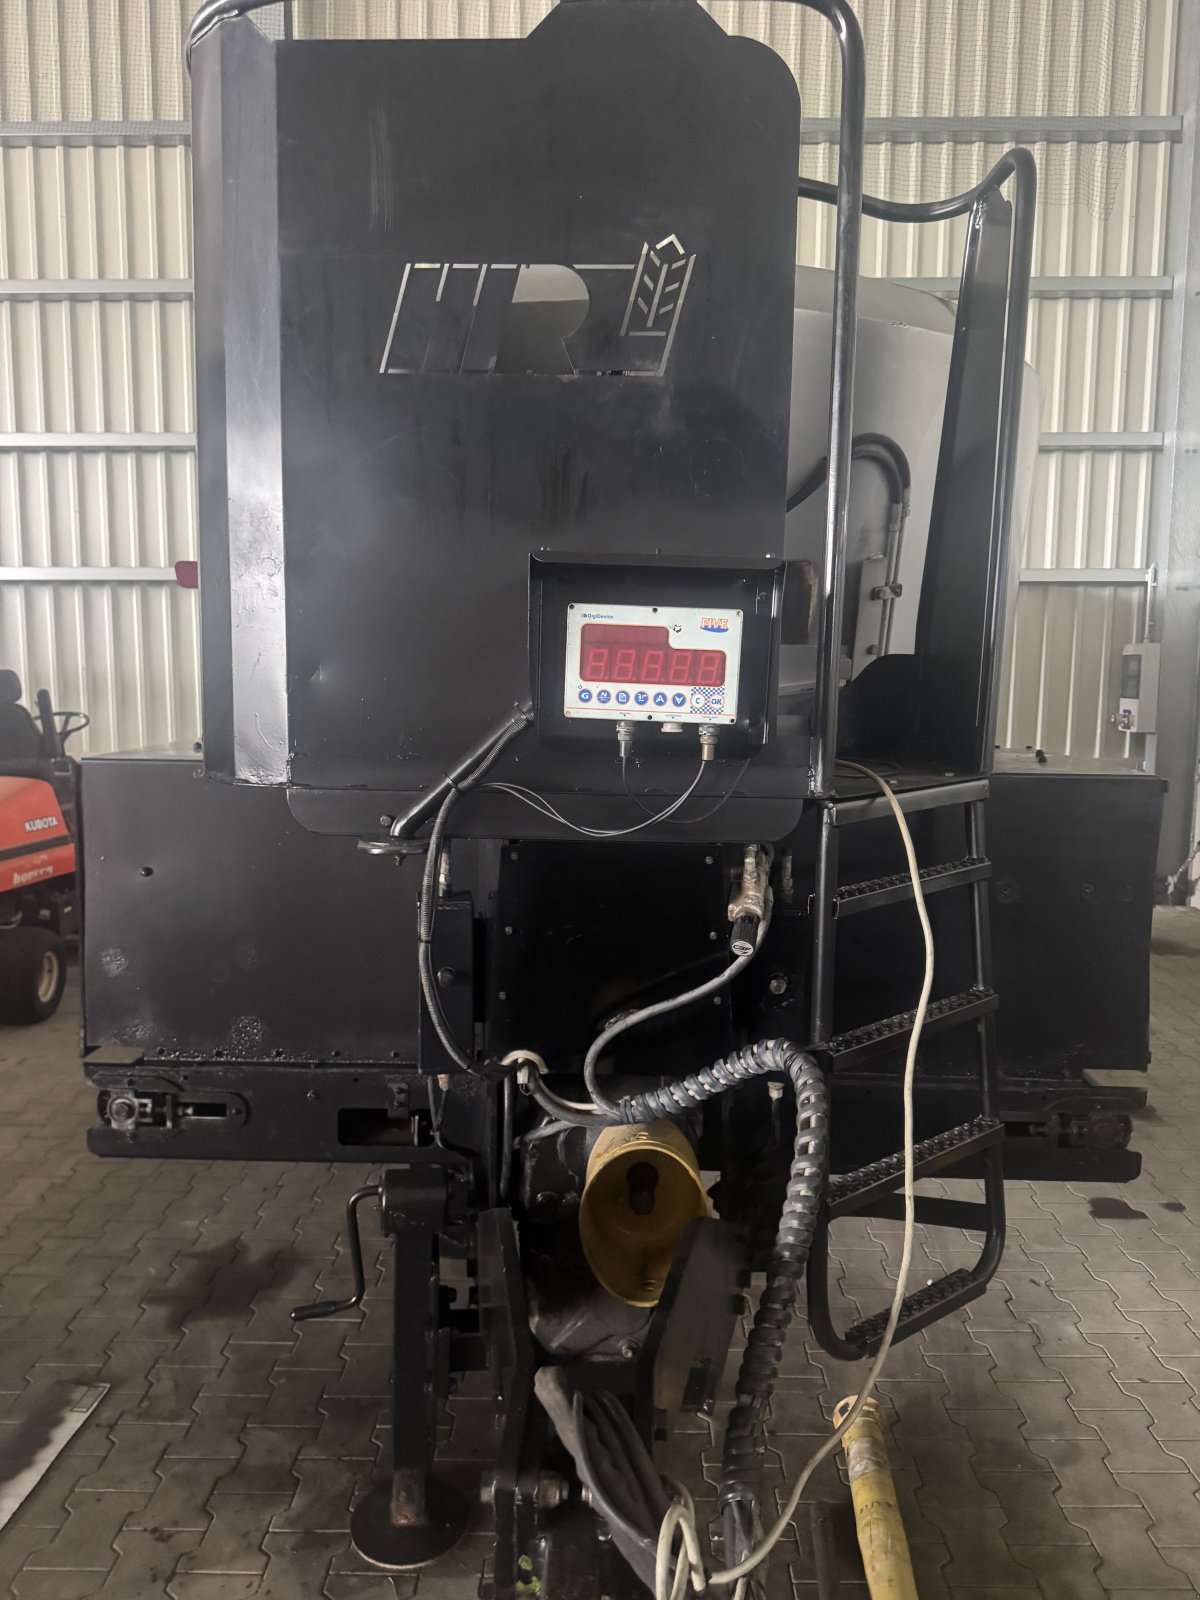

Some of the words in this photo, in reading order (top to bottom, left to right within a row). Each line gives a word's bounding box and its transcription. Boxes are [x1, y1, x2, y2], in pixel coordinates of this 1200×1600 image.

[701, 617, 729, 629] FIVE
[581, 692, 590, 700] G
[695, 697, 702, 705] C
[711, 698, 723, 706] OK
[24, 816, 59, 832] KUBOTA
